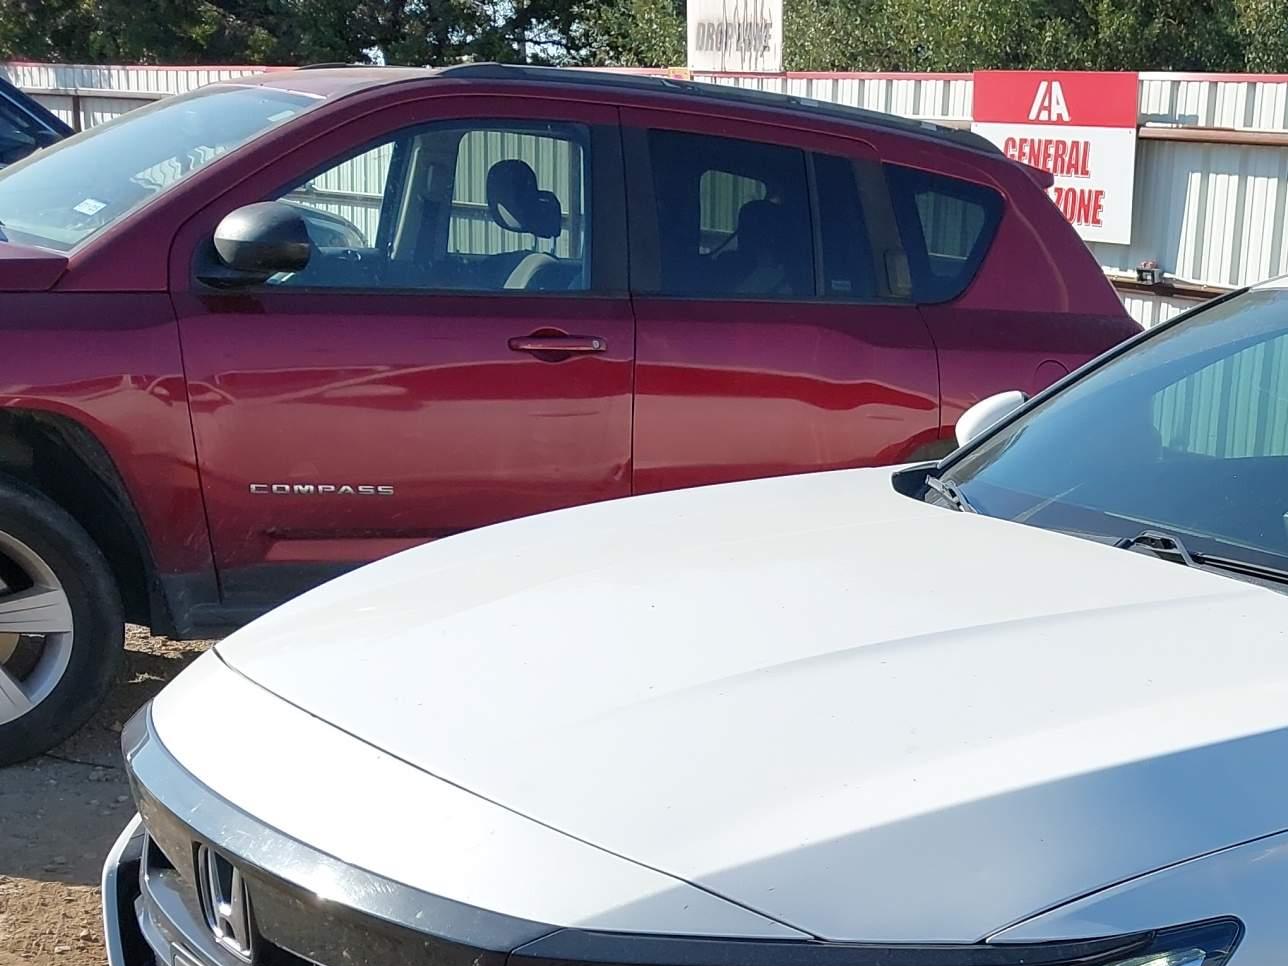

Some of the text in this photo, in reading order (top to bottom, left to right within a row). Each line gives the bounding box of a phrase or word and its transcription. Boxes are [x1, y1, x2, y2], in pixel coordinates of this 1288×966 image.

[695, 22, 732, 51] DROP
[1003, 137, 1091, 178] GENERAL
[1054, 187, 1104, 227] ZONE
[249, 483, 395, 496] COMPASS
